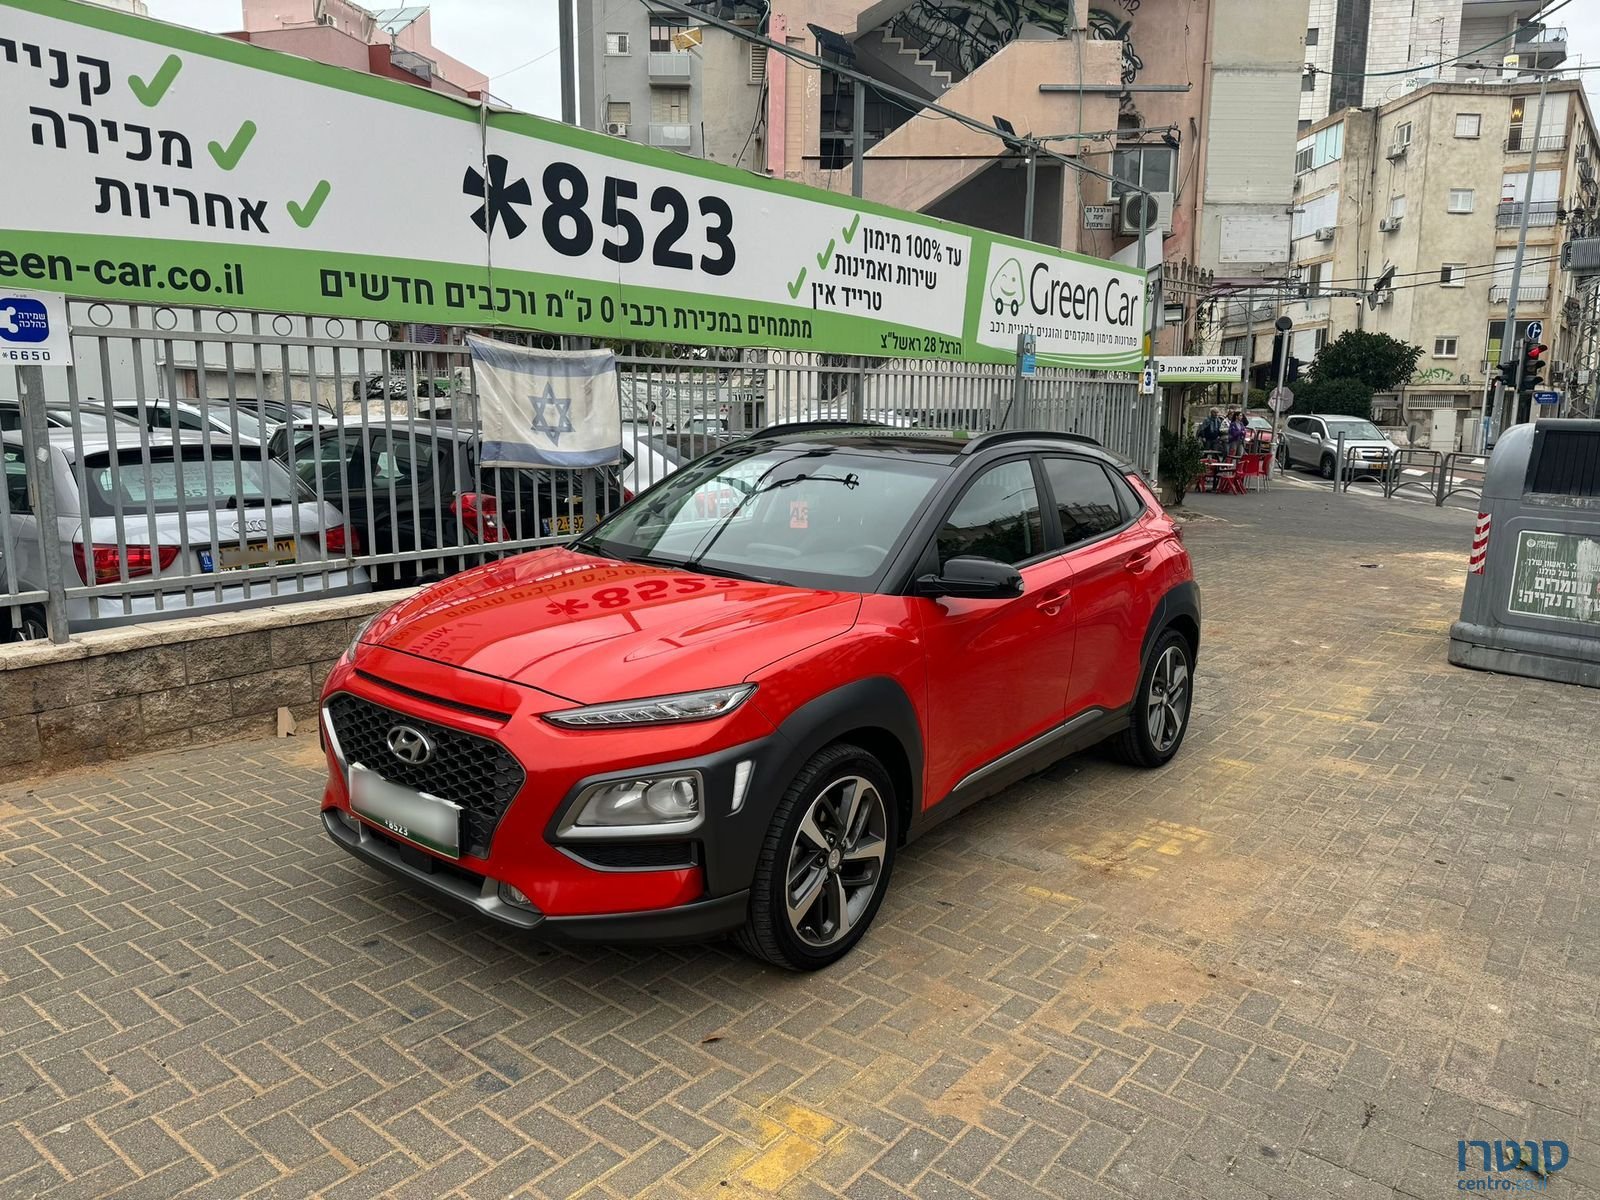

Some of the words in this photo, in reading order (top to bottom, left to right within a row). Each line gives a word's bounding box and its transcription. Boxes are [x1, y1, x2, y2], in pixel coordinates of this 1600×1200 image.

[29, 105, 193, 170] מכירה
[94, 176, 271, 234] אחריות
[863, 227, 901, 254] מימון
[906, 234, 942, 263] 100%
[834, 253, 892, 283] ואמינות
[946, 246, 962, 267] עד
[0, 250, 244, 295] een-car.co.il
[896, 265, 937, 290] שירות
[320, 268, 434, 306] חדשים
[445, 281, 536, 315] ורכבים
[811, 282, 837, 310] אין
[841, 286, 882, 311] טרייד
[1030, 262, 1099, 322] Green
[1105, 278, 1138, 327] Car
[18, 312, 46, 320] שמירה
[545, 289, 591, 322] ק"מ
[600, 295, 614, 323] 0
[621, 302, 667, 328] רכבי
[19, 320, 47, 329] כהלכה
[673, 306, 742, 333] במכירת
[748, 314, 812, 338] מתמחים
[990, 320, 1005, 333] רכב
[924, 336, 936, 352] 28
[1036, 326, 1062, 339] והוגנים
[1064, 329, 1095, 343] מתקדמים
[1096, 333, 1113, 345] מימון
[1114, 334, 1138, 347] פתרונות
[939, 339, 962, 355] הרצל
[1159, 364, 1166, 373] 3
[1189, 365, 1205, 374] קצת
[1216, 365, 1238, 373] אצלנו
[1221, 358, 1238, 366] שלם
[1534, 576, 1592, 595] שומרים
